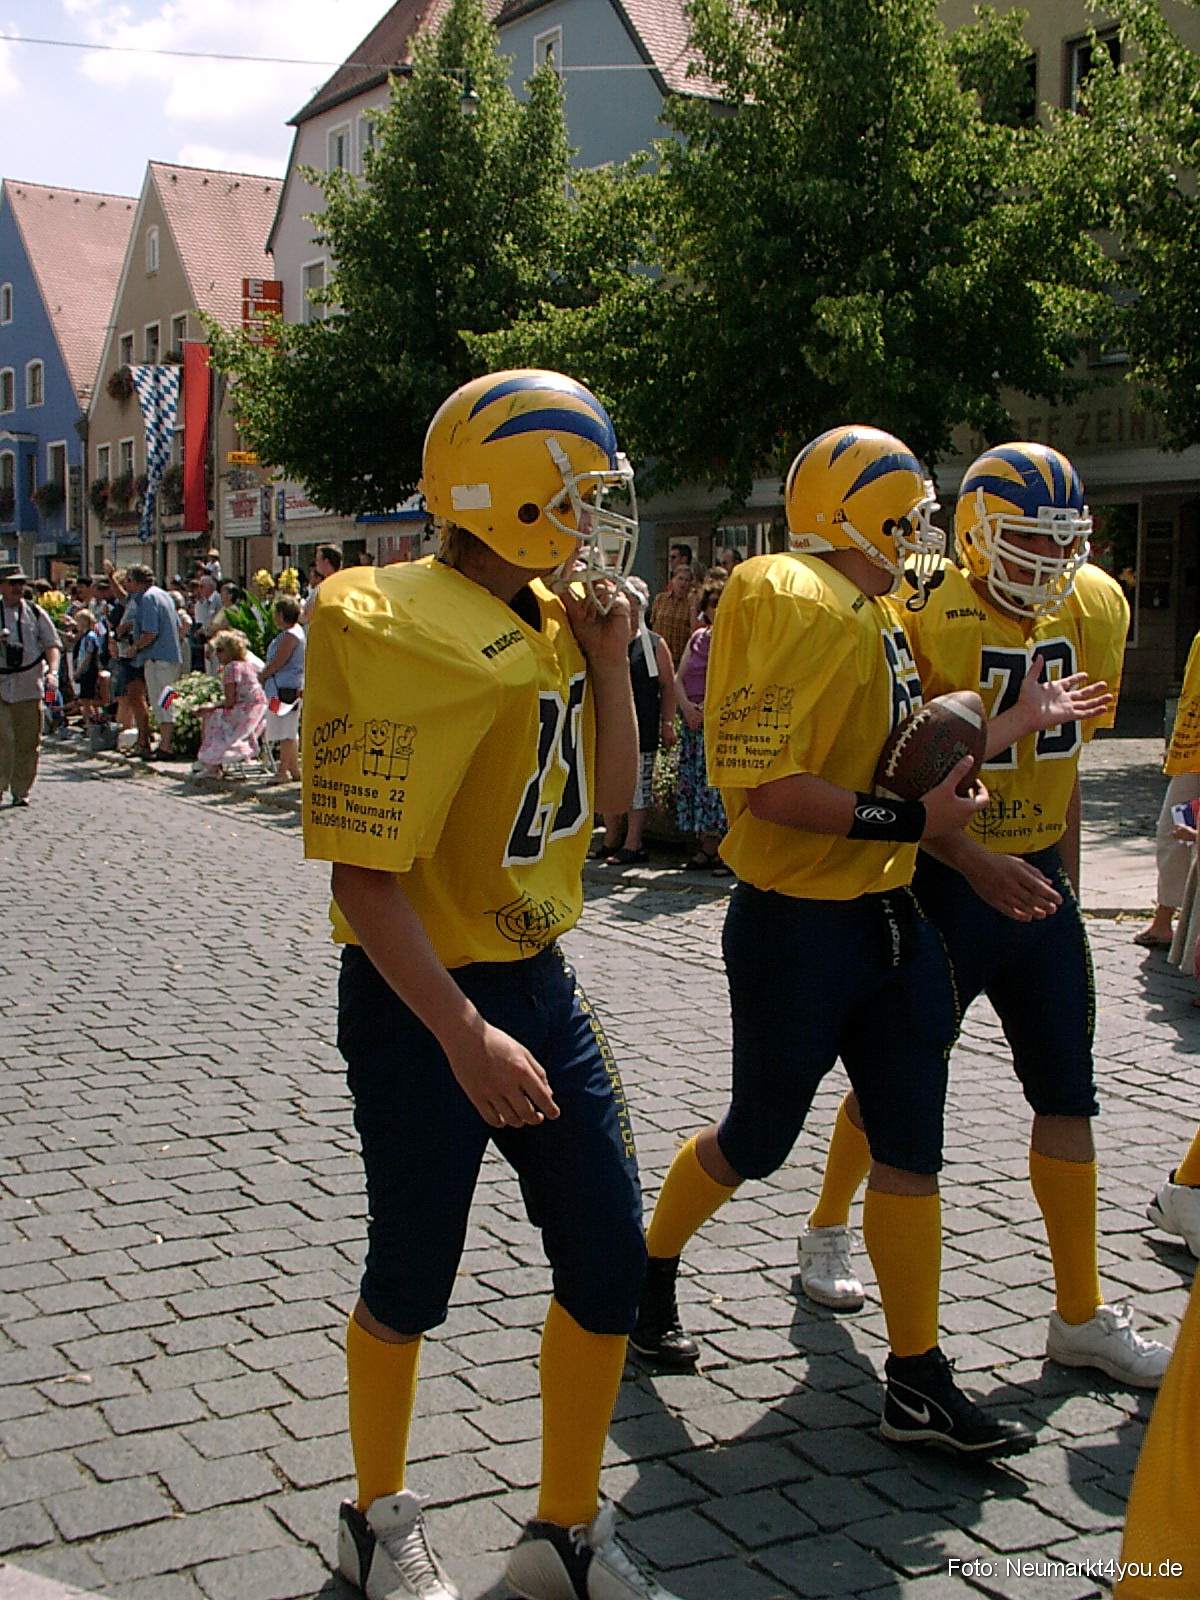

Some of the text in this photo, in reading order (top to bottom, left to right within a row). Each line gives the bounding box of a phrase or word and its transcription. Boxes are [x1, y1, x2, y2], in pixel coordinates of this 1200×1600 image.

[314, 743, 351, 769] Shop
[311, 775, 405, 803] Glasergasse 22
[345, 799, 403, 821] Neumarkt
[369, 823, 384, 837] 42
